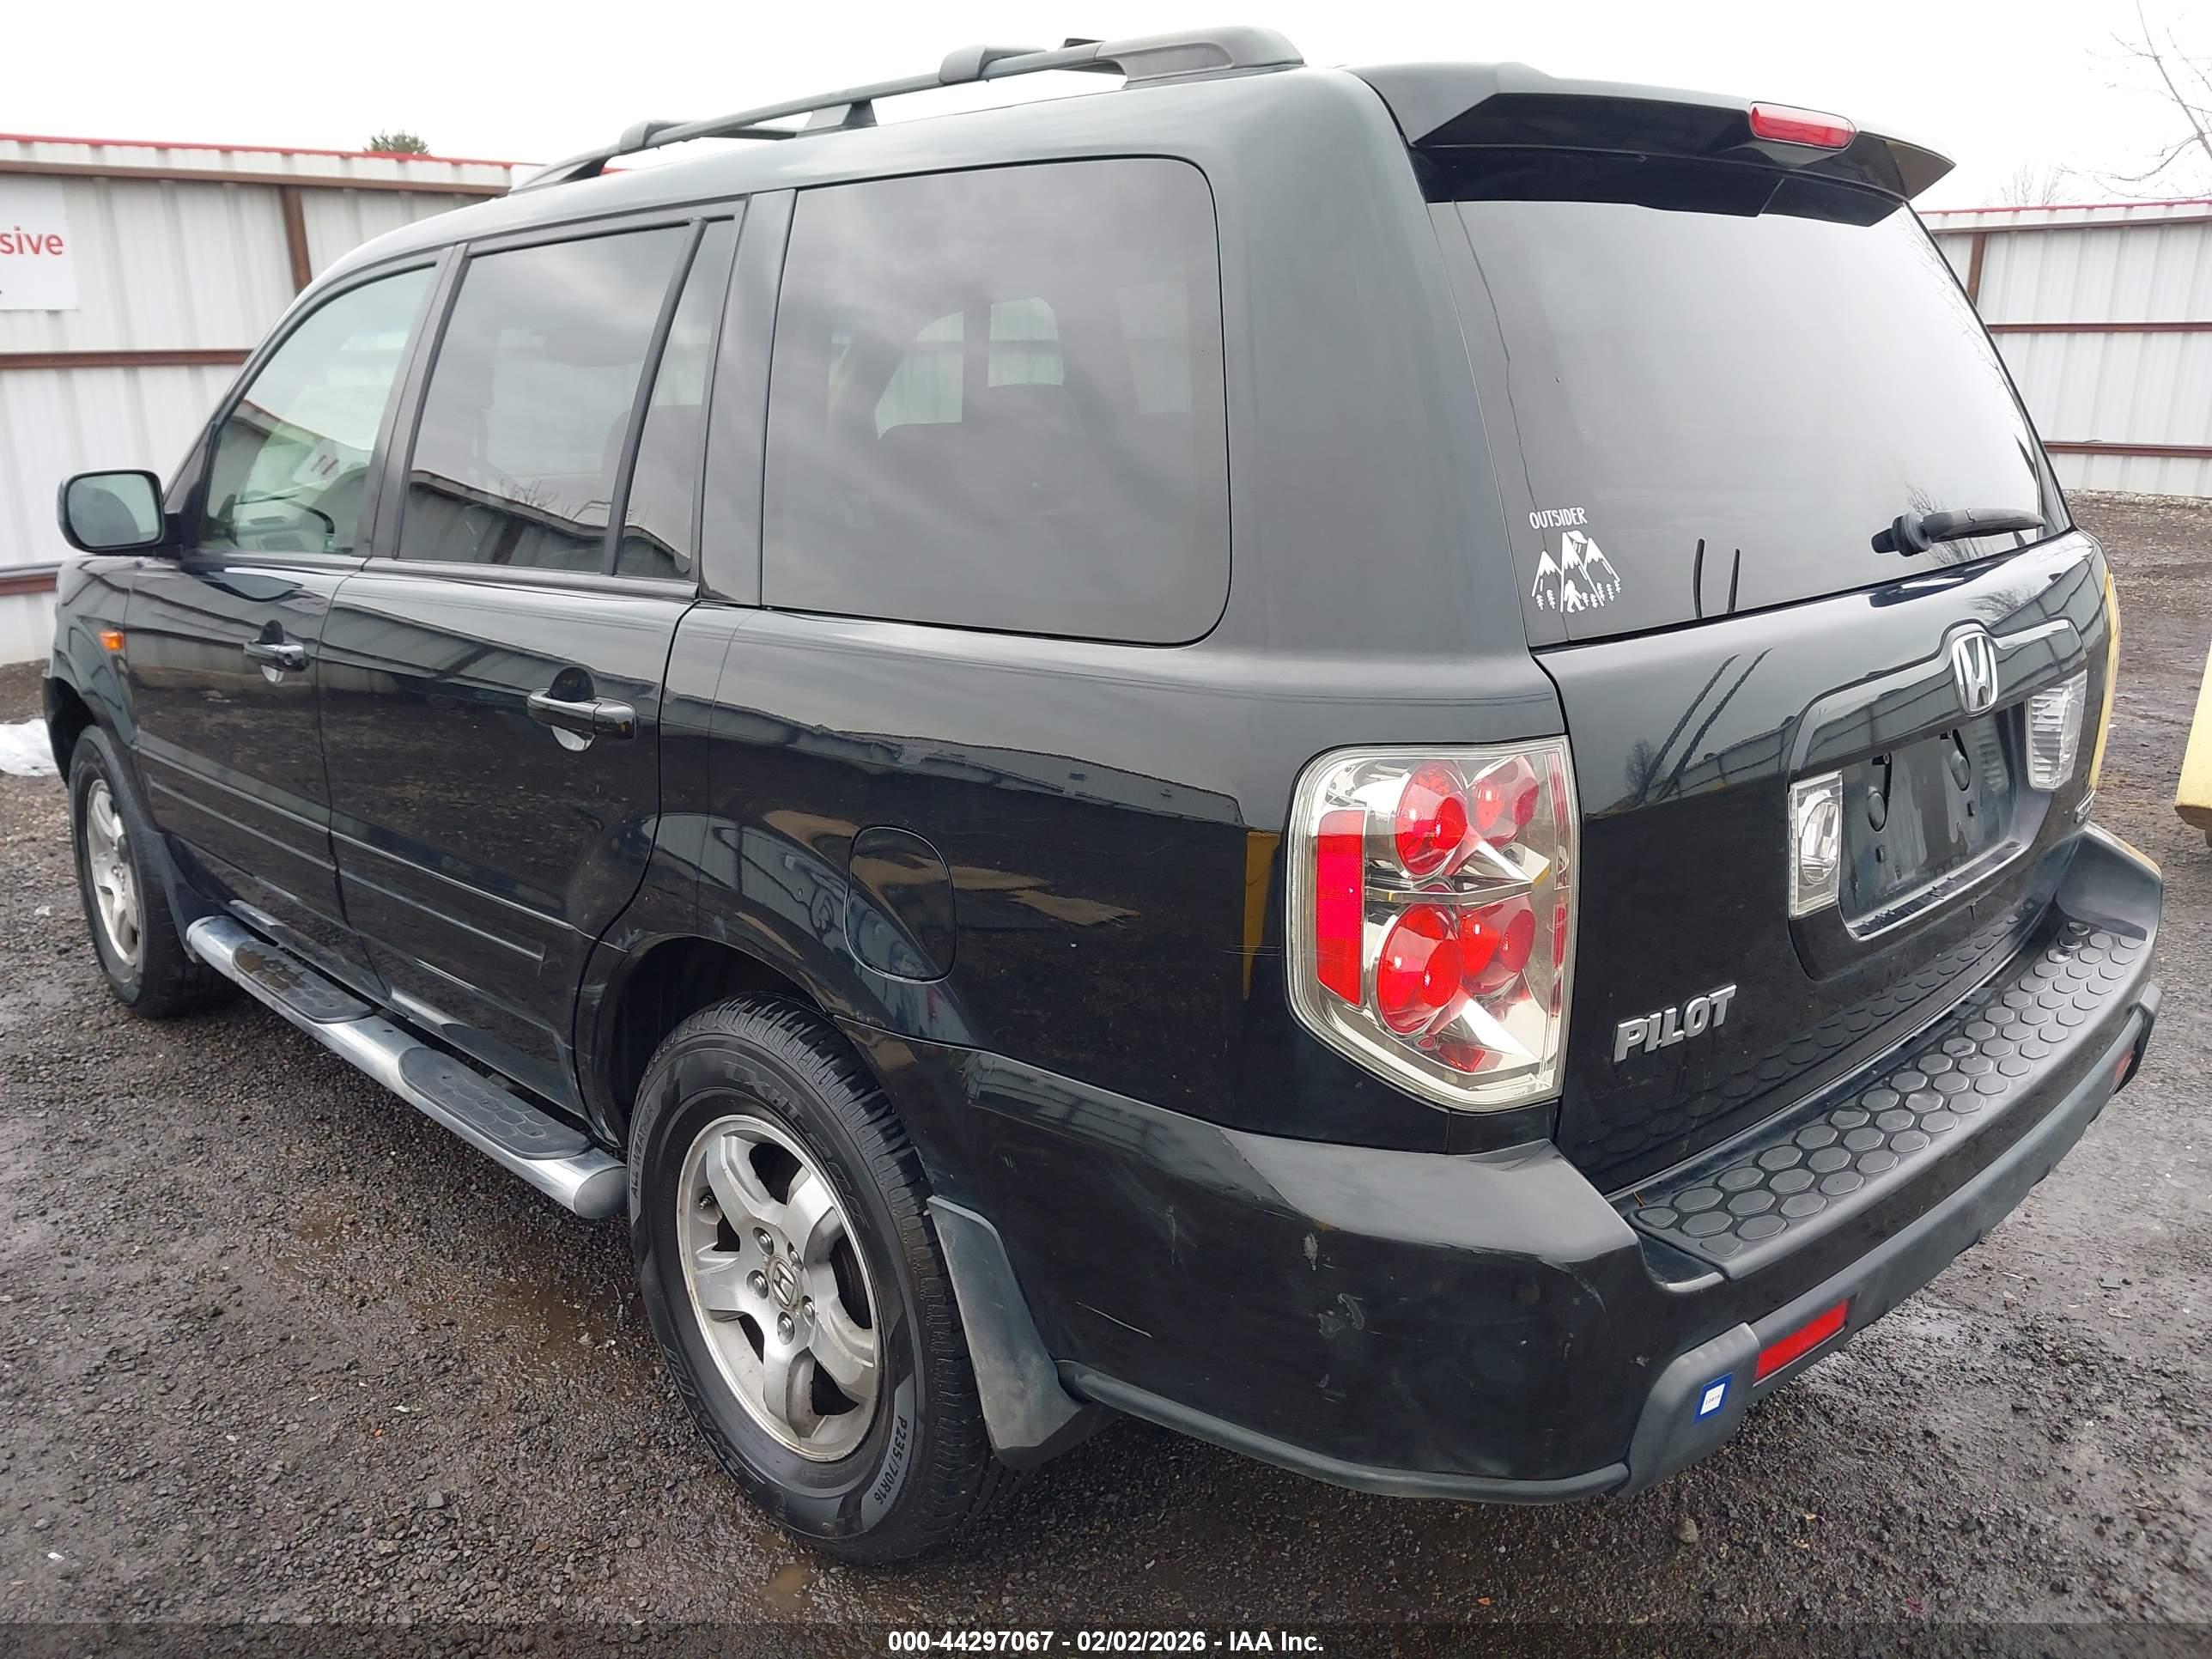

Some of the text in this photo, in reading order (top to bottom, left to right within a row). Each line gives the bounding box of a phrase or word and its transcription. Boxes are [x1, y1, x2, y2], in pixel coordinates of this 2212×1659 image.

[0, 225, 64, 255] sive
[1528, 507, 1588, 530] OUTSIDER
[1613, 984, 1737, 1063] PILOT
[630, 1170, 639, 1199] ALL
[874, 1415, 908, 1505] P235/70R16
